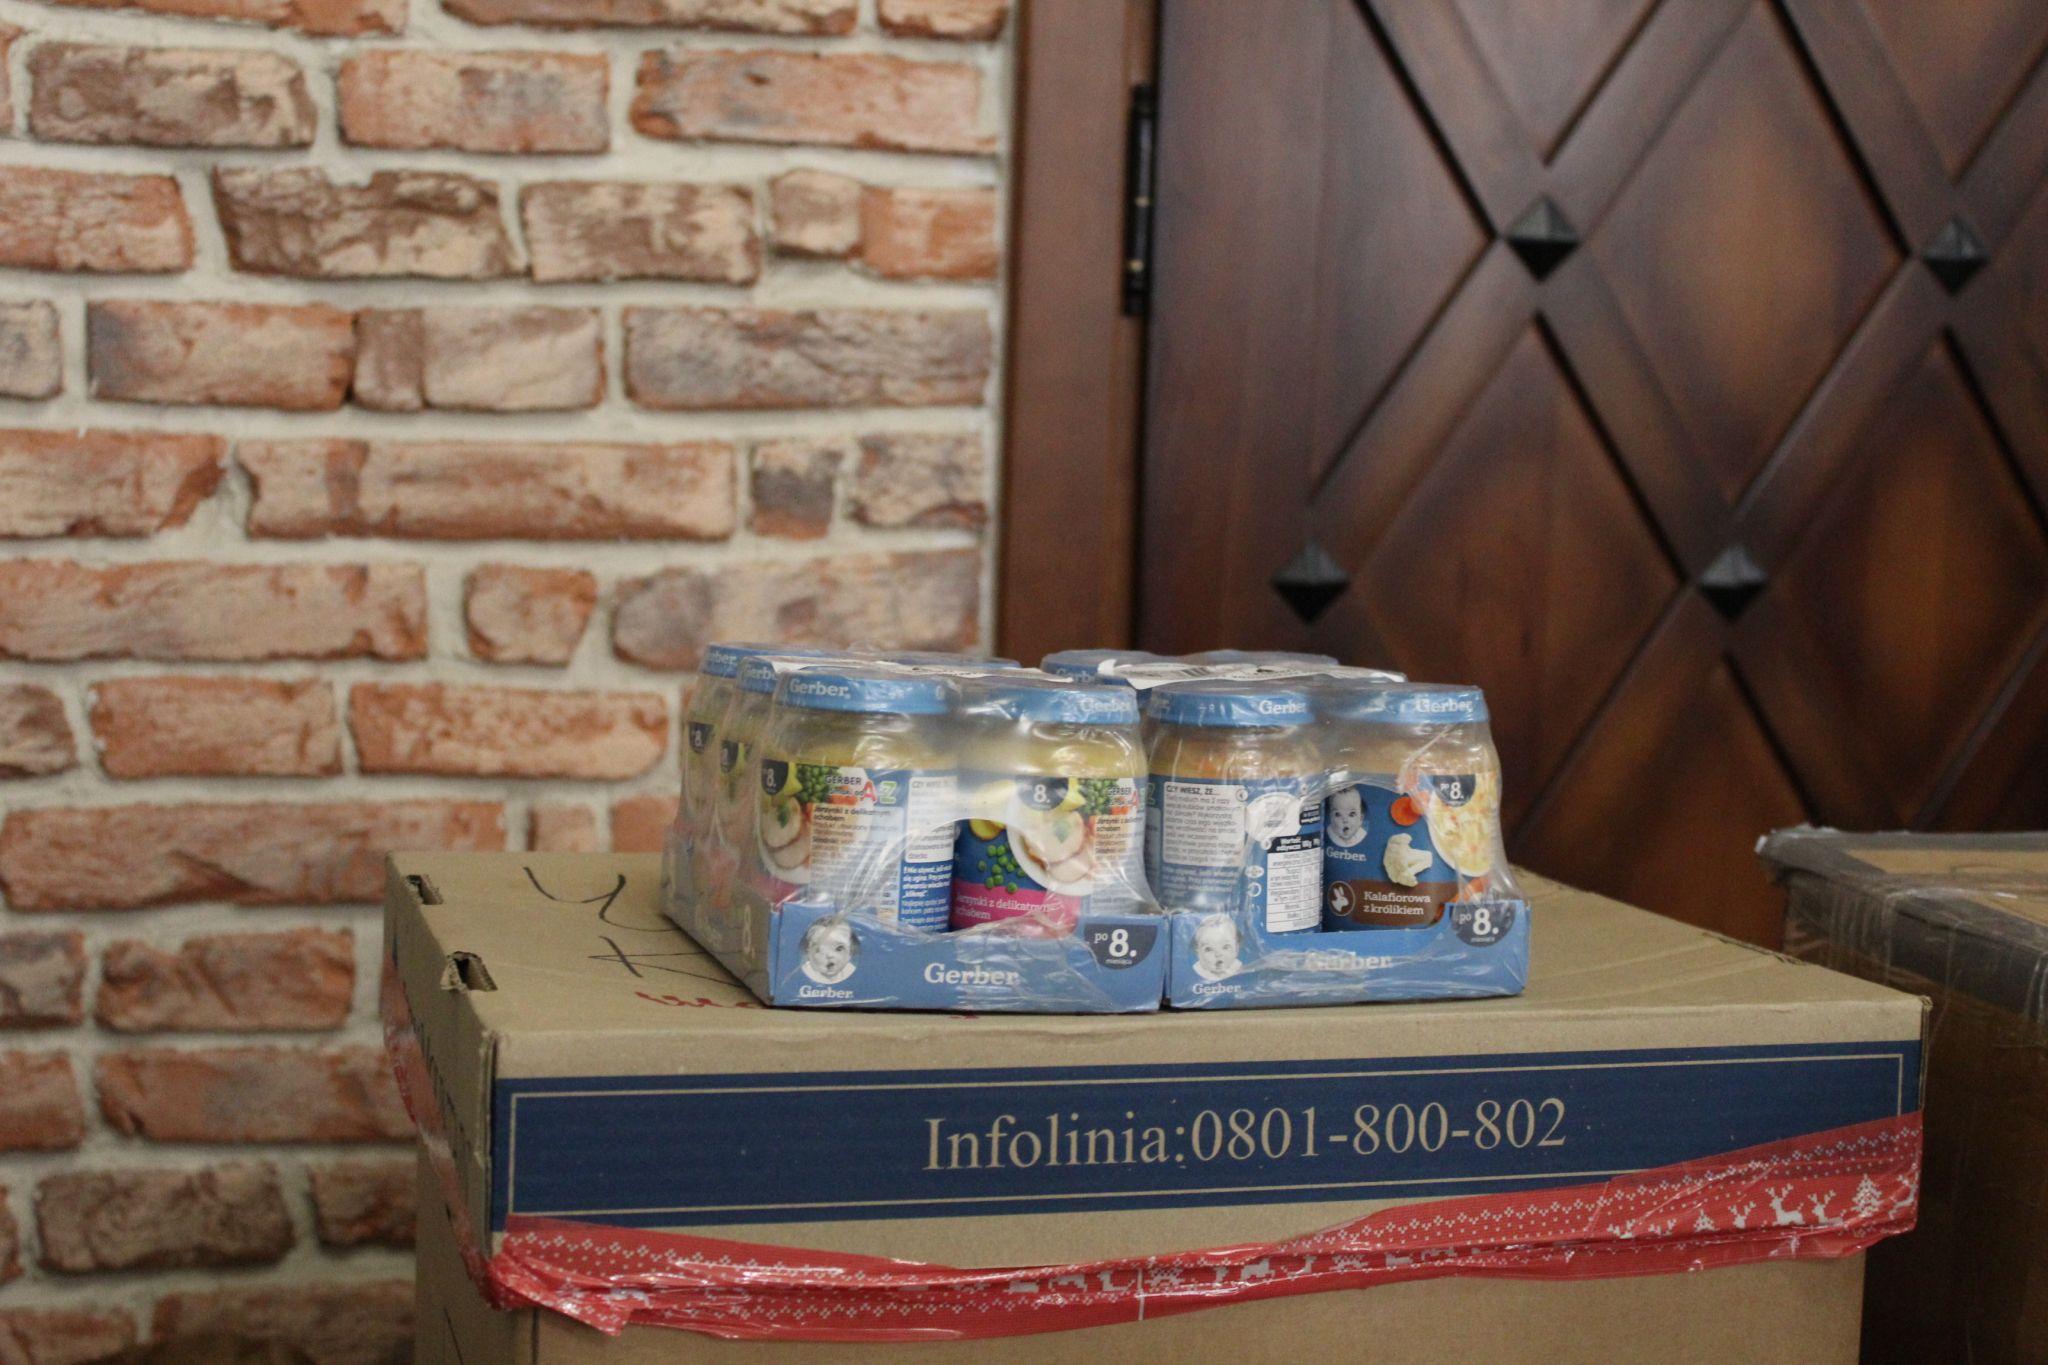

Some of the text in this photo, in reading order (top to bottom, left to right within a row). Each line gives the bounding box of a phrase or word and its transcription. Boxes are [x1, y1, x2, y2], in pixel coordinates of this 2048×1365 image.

[789, 678, 848, 697] Gerber
[825, 775, 862, 785] GERBER
[1033, 784, 1051, 804] 8.
[1450, 782, 1464, 799] 8.
[1327, 847, 1366, 861] Gerber
[1364, 891, 1431, 903] Kalafiorowa
[1371, 905, 1424, 916] królikiem
[1459, 908, 1499, 935] po 8.
[1094, 928, 1137, 958] po 8.
[924, 962, 1019, 986] Gerber
[800, 984, 852, 999] Gerber
[1192, 983, 1241, 995] Gerber
